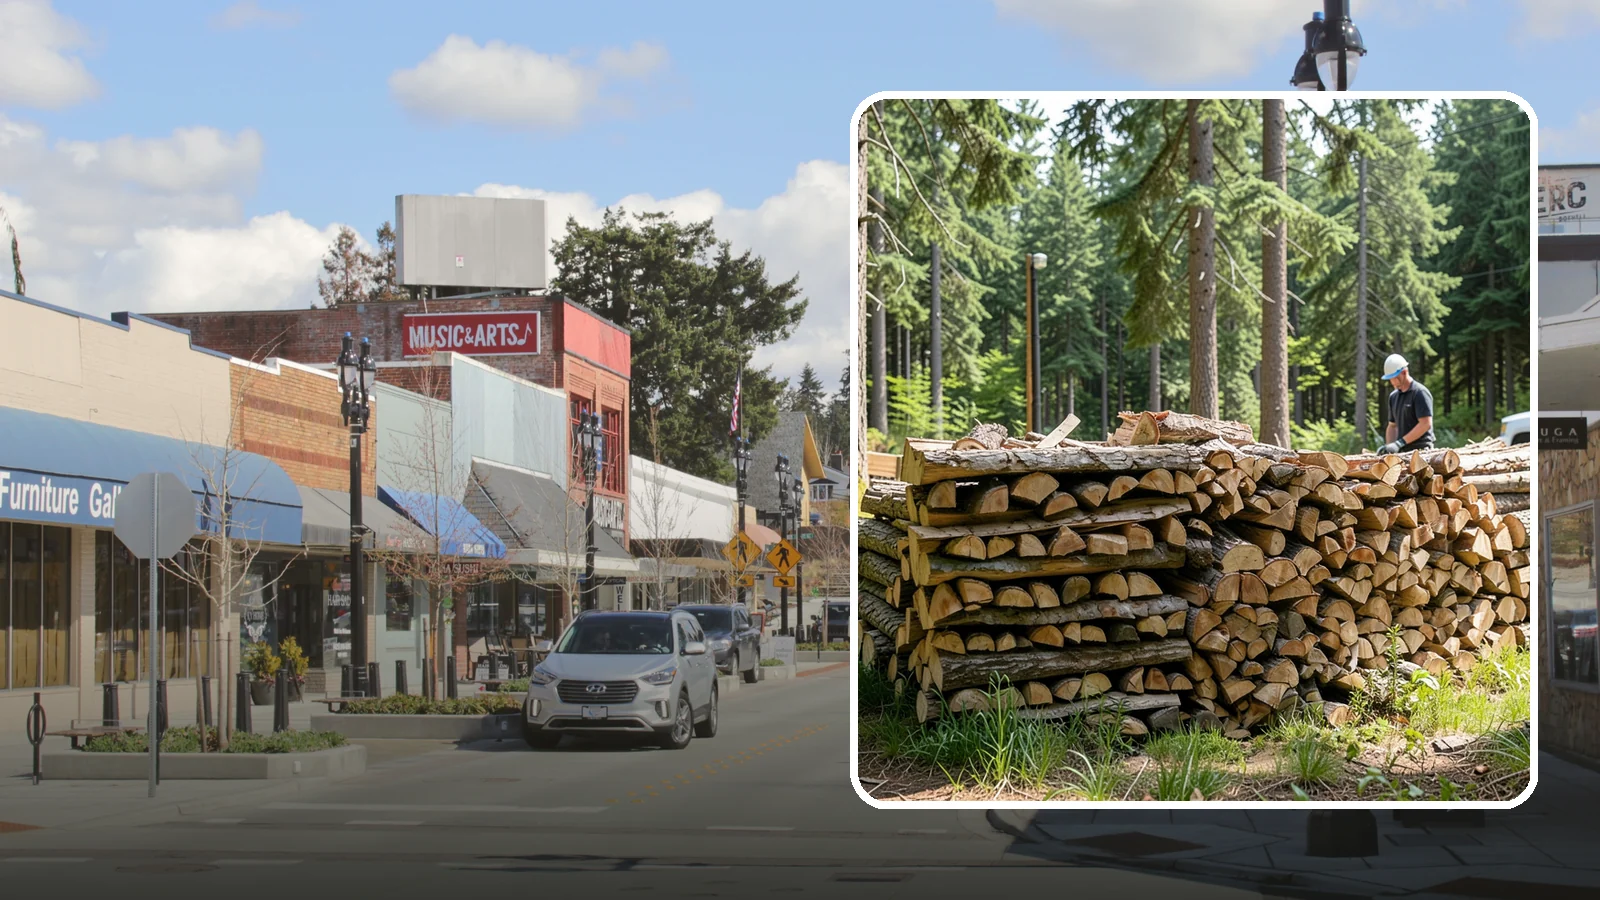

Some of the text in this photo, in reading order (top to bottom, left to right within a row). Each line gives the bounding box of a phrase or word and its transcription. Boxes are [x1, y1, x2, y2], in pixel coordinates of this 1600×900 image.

[409, 323, 519, 349] MUSIC&ARTS
[1540, 427, 1577, 436] UGA
[0, 472, 79, 515] Furniture
